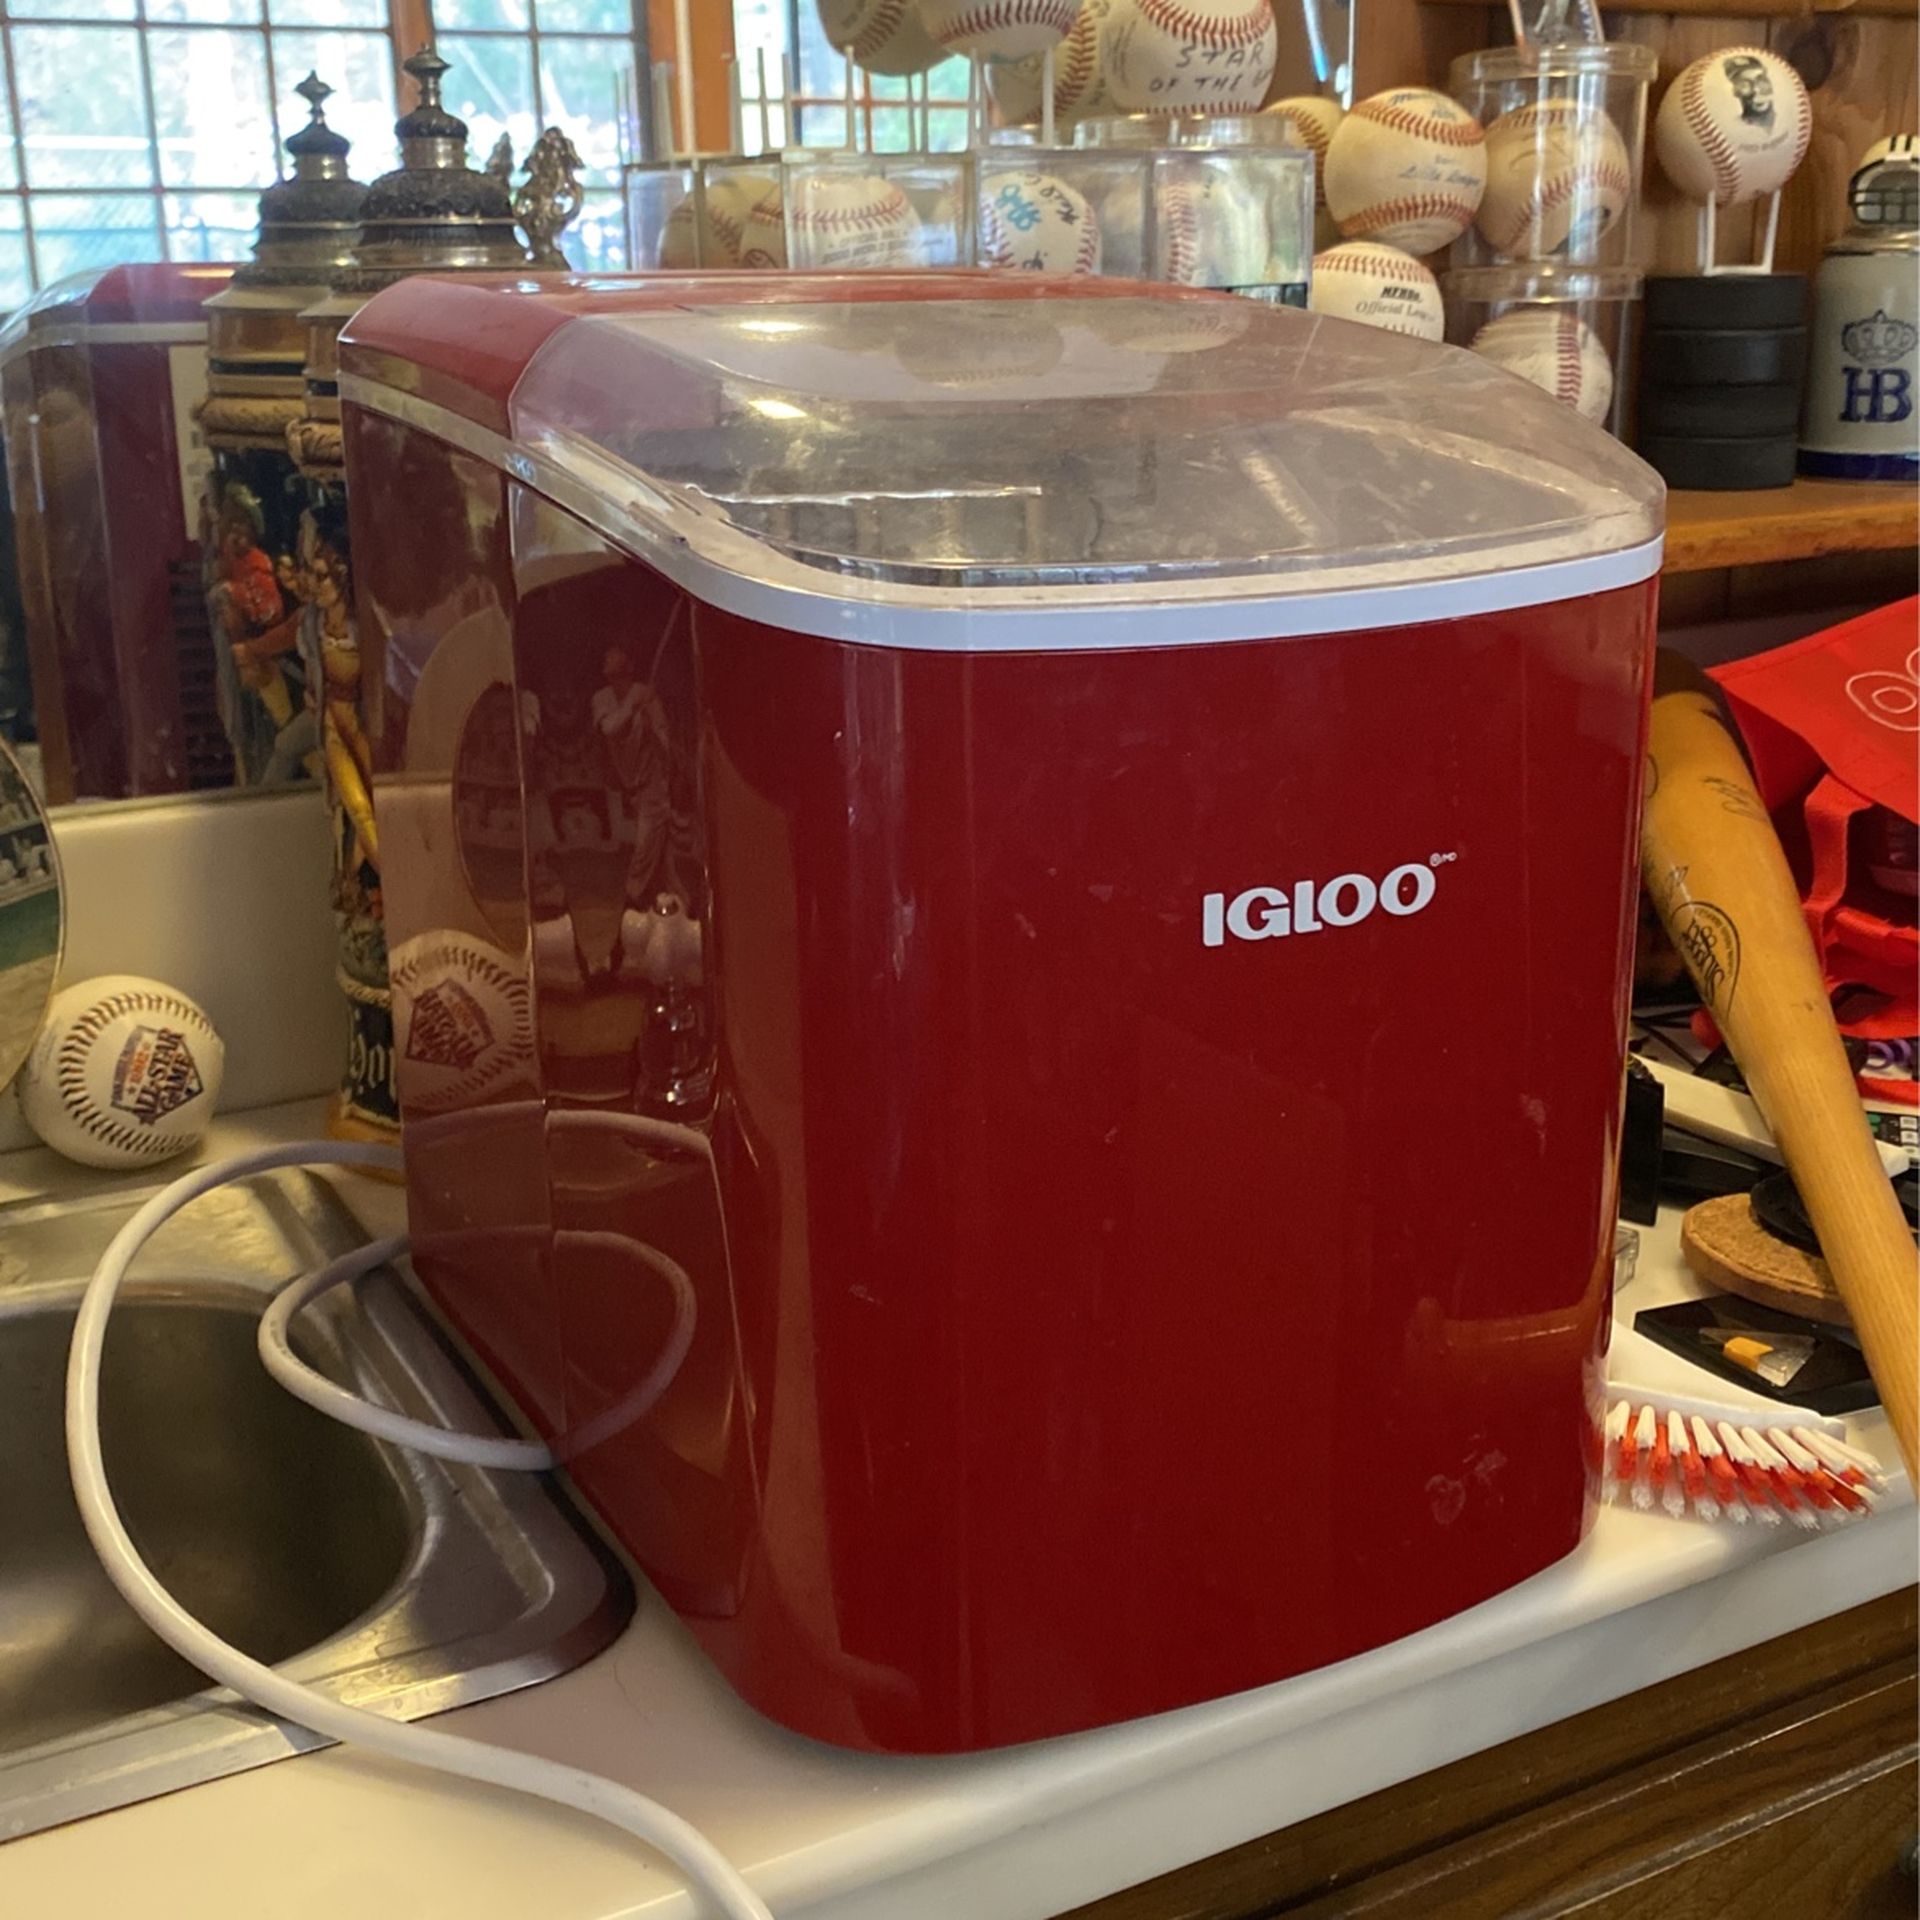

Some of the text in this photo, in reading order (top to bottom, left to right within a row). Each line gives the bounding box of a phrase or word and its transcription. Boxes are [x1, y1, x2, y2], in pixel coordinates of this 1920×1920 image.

[1175, 41, 1265, 68] STAR
[1150, 77, 1179, 93] OF
[1355, 301, 1403, 316] Official
[1839, 366, 1912, 422] HB
[1203, 863, 1436, 947] IGLOO
